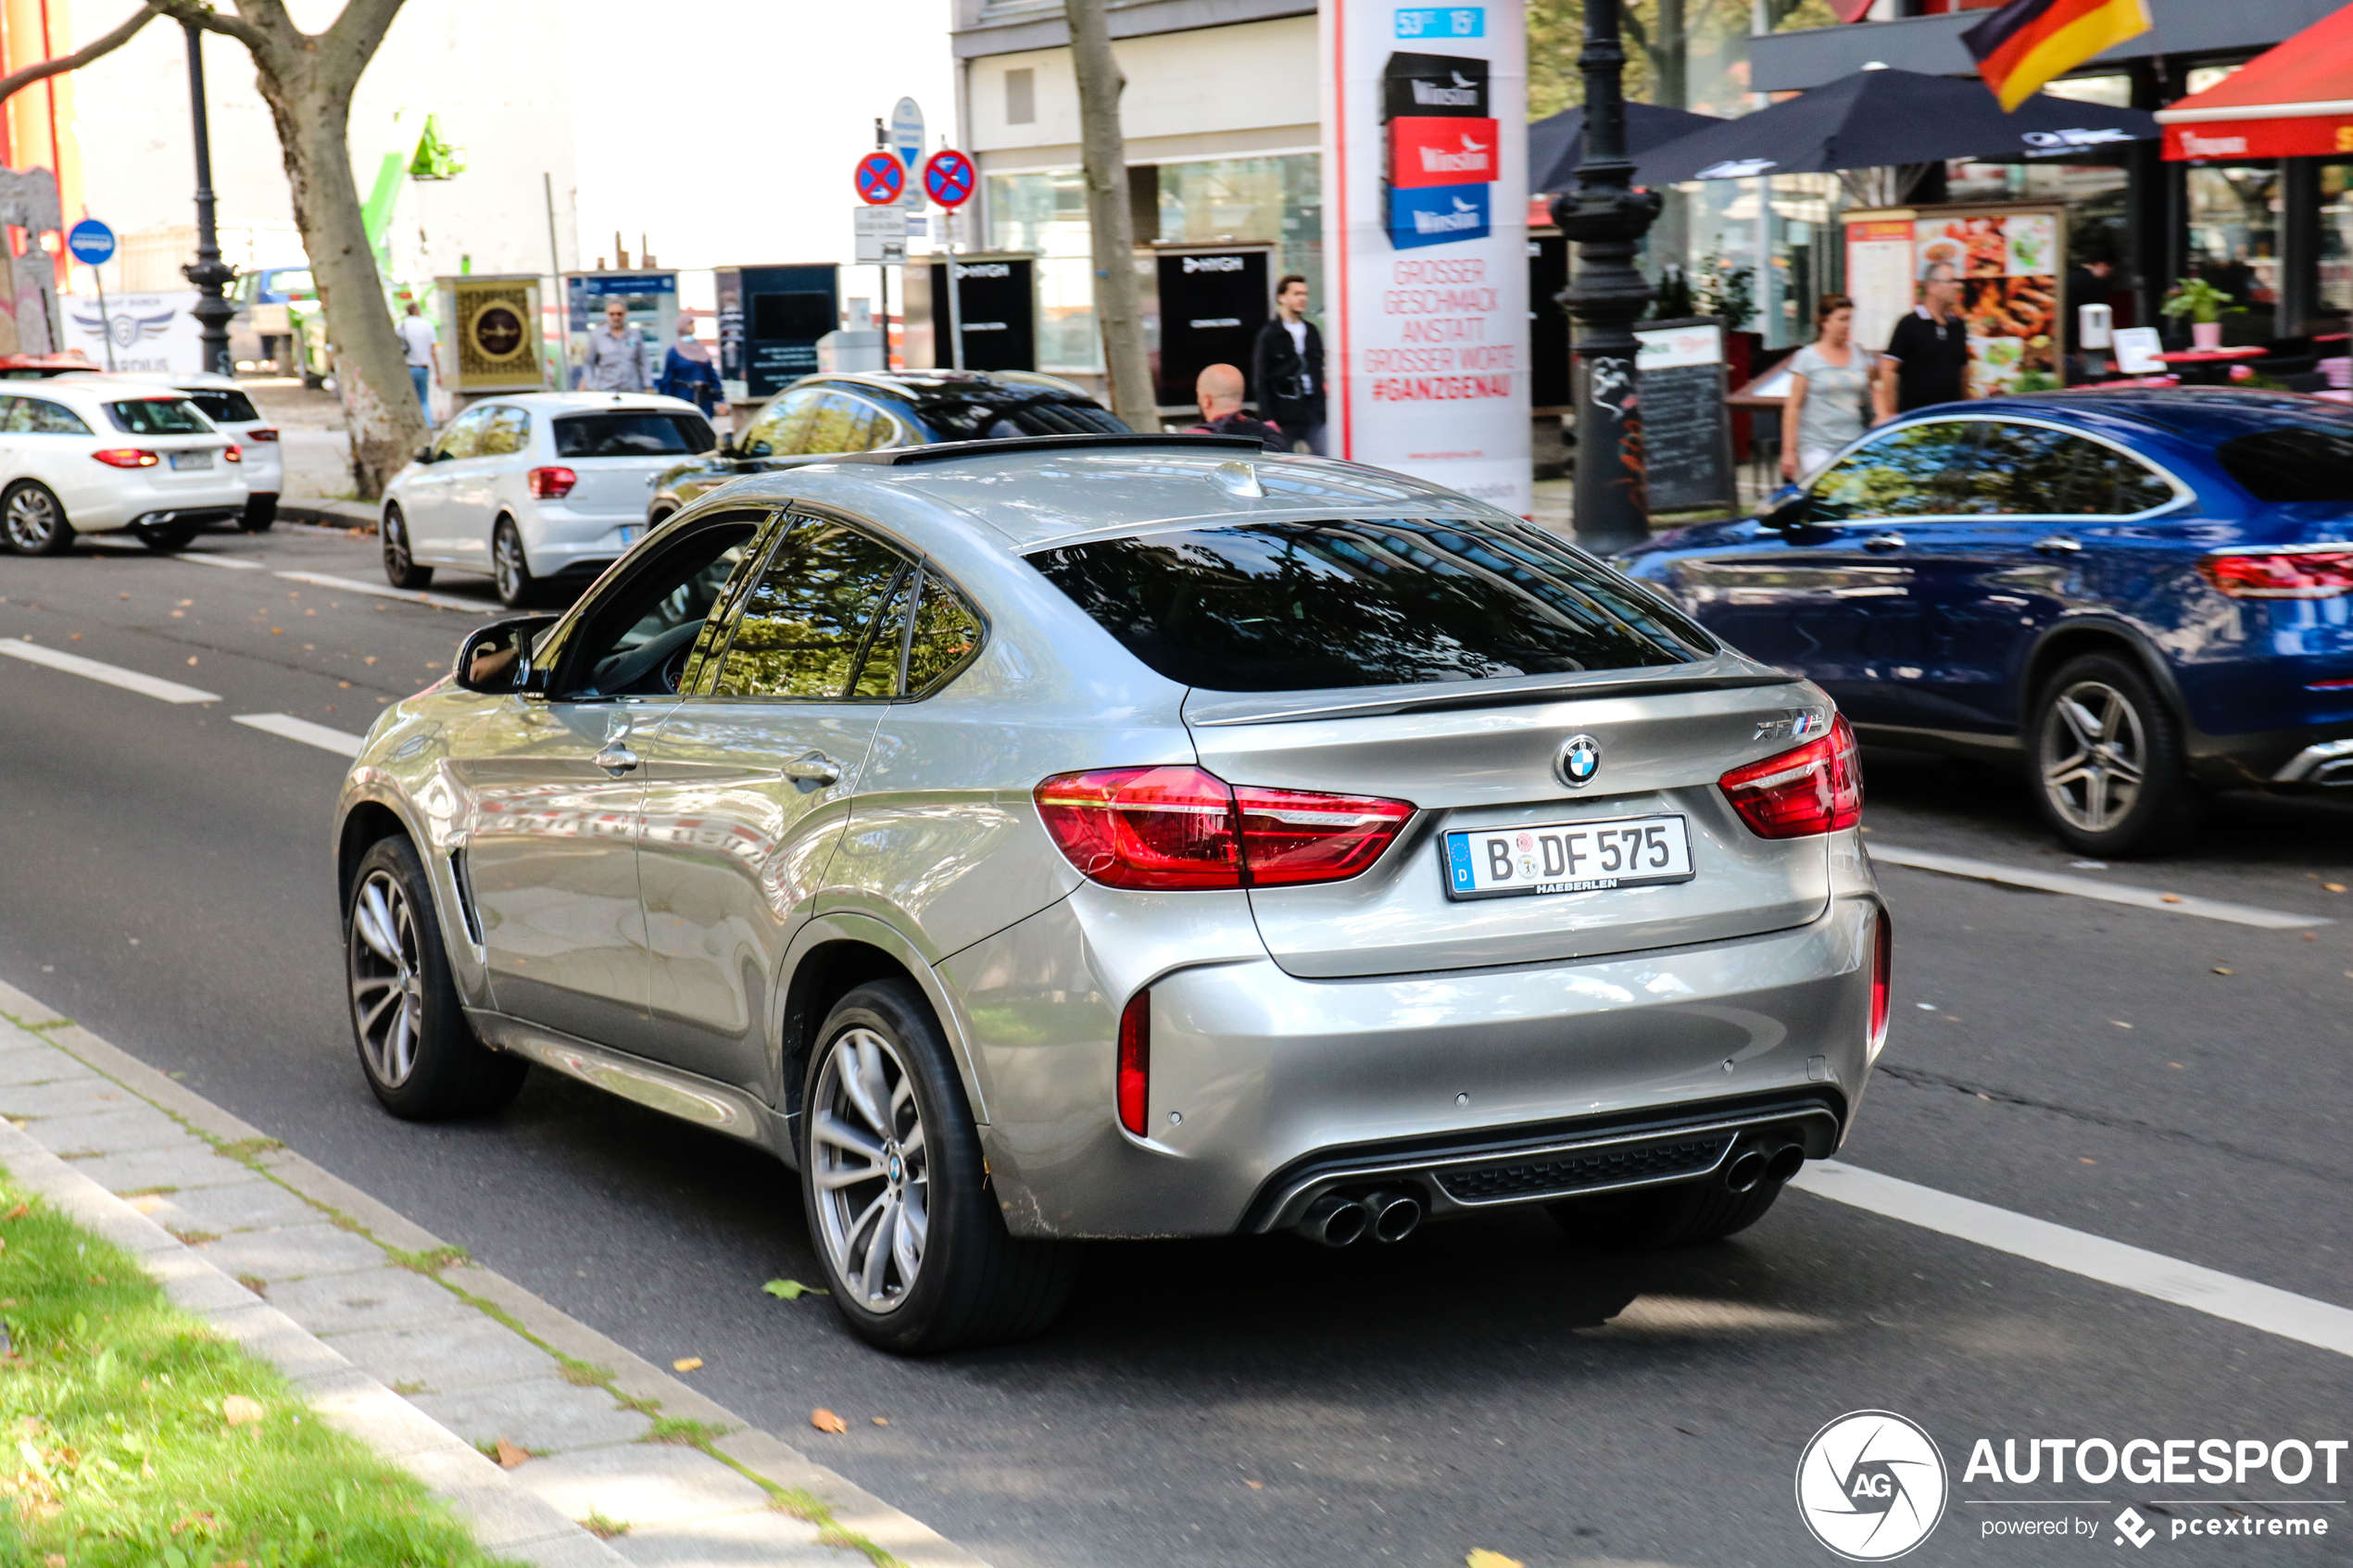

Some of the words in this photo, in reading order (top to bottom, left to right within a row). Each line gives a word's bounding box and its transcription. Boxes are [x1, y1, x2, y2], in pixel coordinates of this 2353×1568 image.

[1393, 258, 1485, 284] GROSSER
[1384, 287, 1501, 315] GESCHMACK
[1402, 317, 1486, 344] ANSTATT
[1364, 347, 1454, 373] GROSSER
[1459, 345, 1516, 370] WORTE
[1371, 374, 1513, 402] #GANZGENAU
[1567, 742, 1598, 757] BMW
[1487, 838, 1513, 881] B
[1539, 833, 1588, 877] DF
[1596, 826, 1669, 872] 575
[1536, 878, 1618, 895] HAEBERLEN
